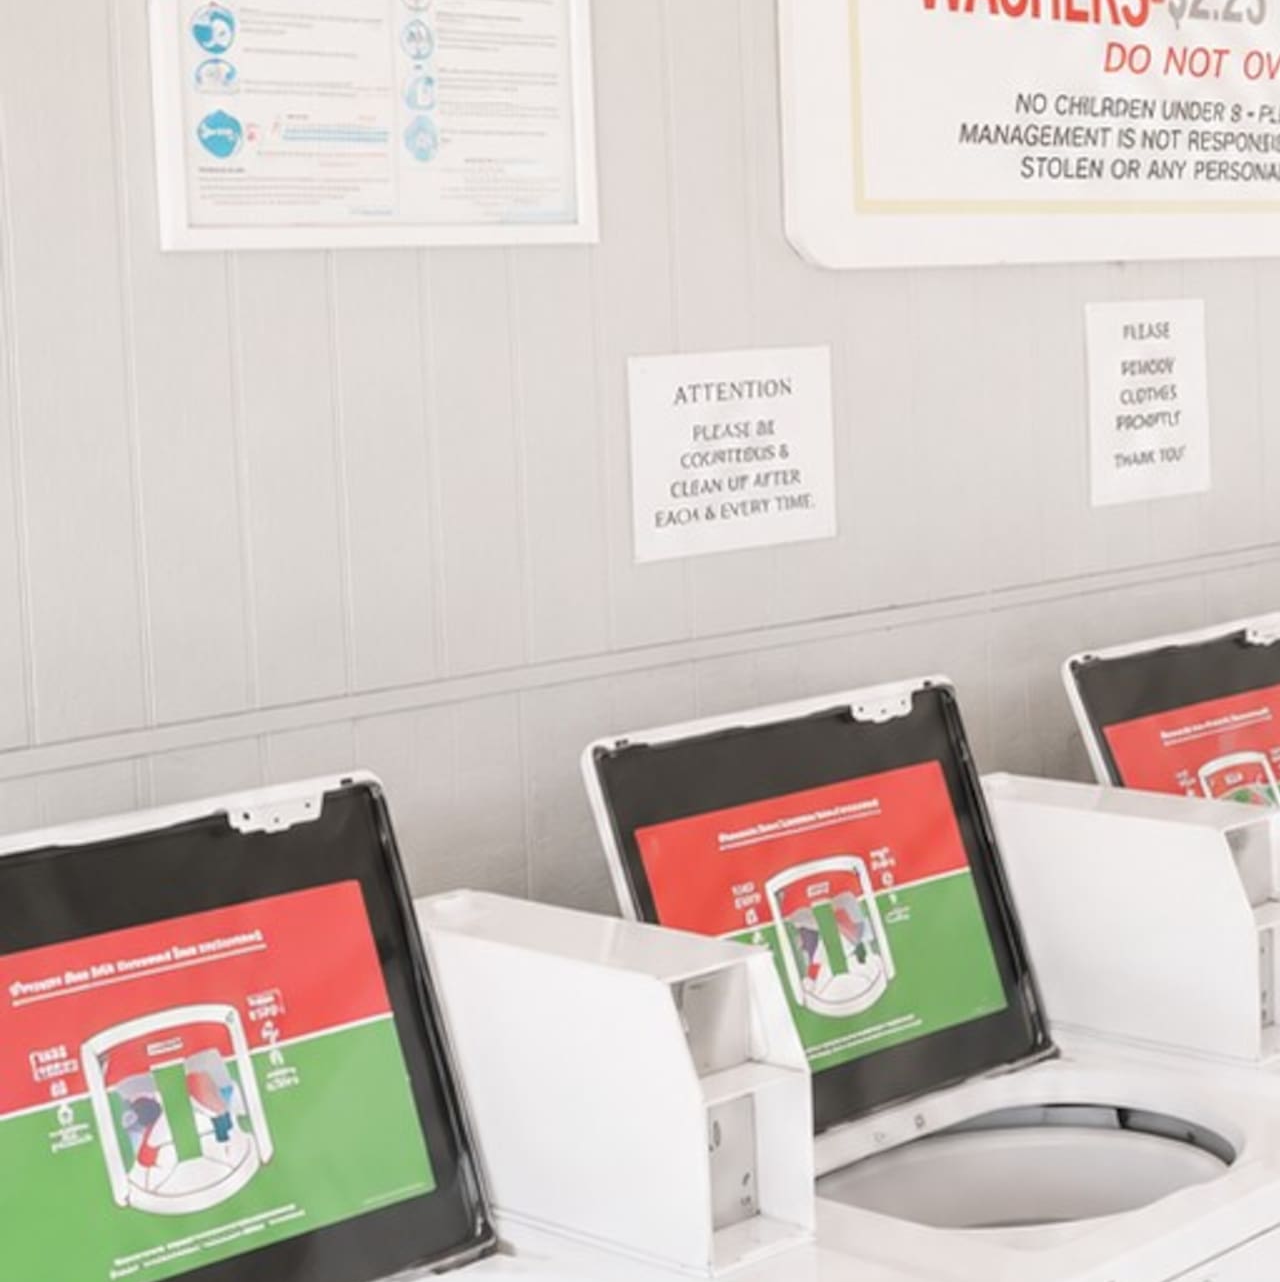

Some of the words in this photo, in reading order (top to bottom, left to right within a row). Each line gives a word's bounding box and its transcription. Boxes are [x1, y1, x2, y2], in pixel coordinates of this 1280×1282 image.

[1104, 41, 1151, 75] DO
[1164, 46, 1230, 79] NOT
[1015, 92, 1047, 115] NO
[1161, 99, 1225, 122] UNDER
[958, 122, 1112, 149] MANAGEMENT
[1117, 128, 1136, 150] IS
[1141, 129, 1182, 151] NOT
[1020, 156, 1101, 180] STOLEN
[1111, 158, 1141, 180] OR
[1147, 159, 1187, 181] ANY
[673, 377, 793, 406] ATTENTION
[670, 478, 723, 499] CLEAN
